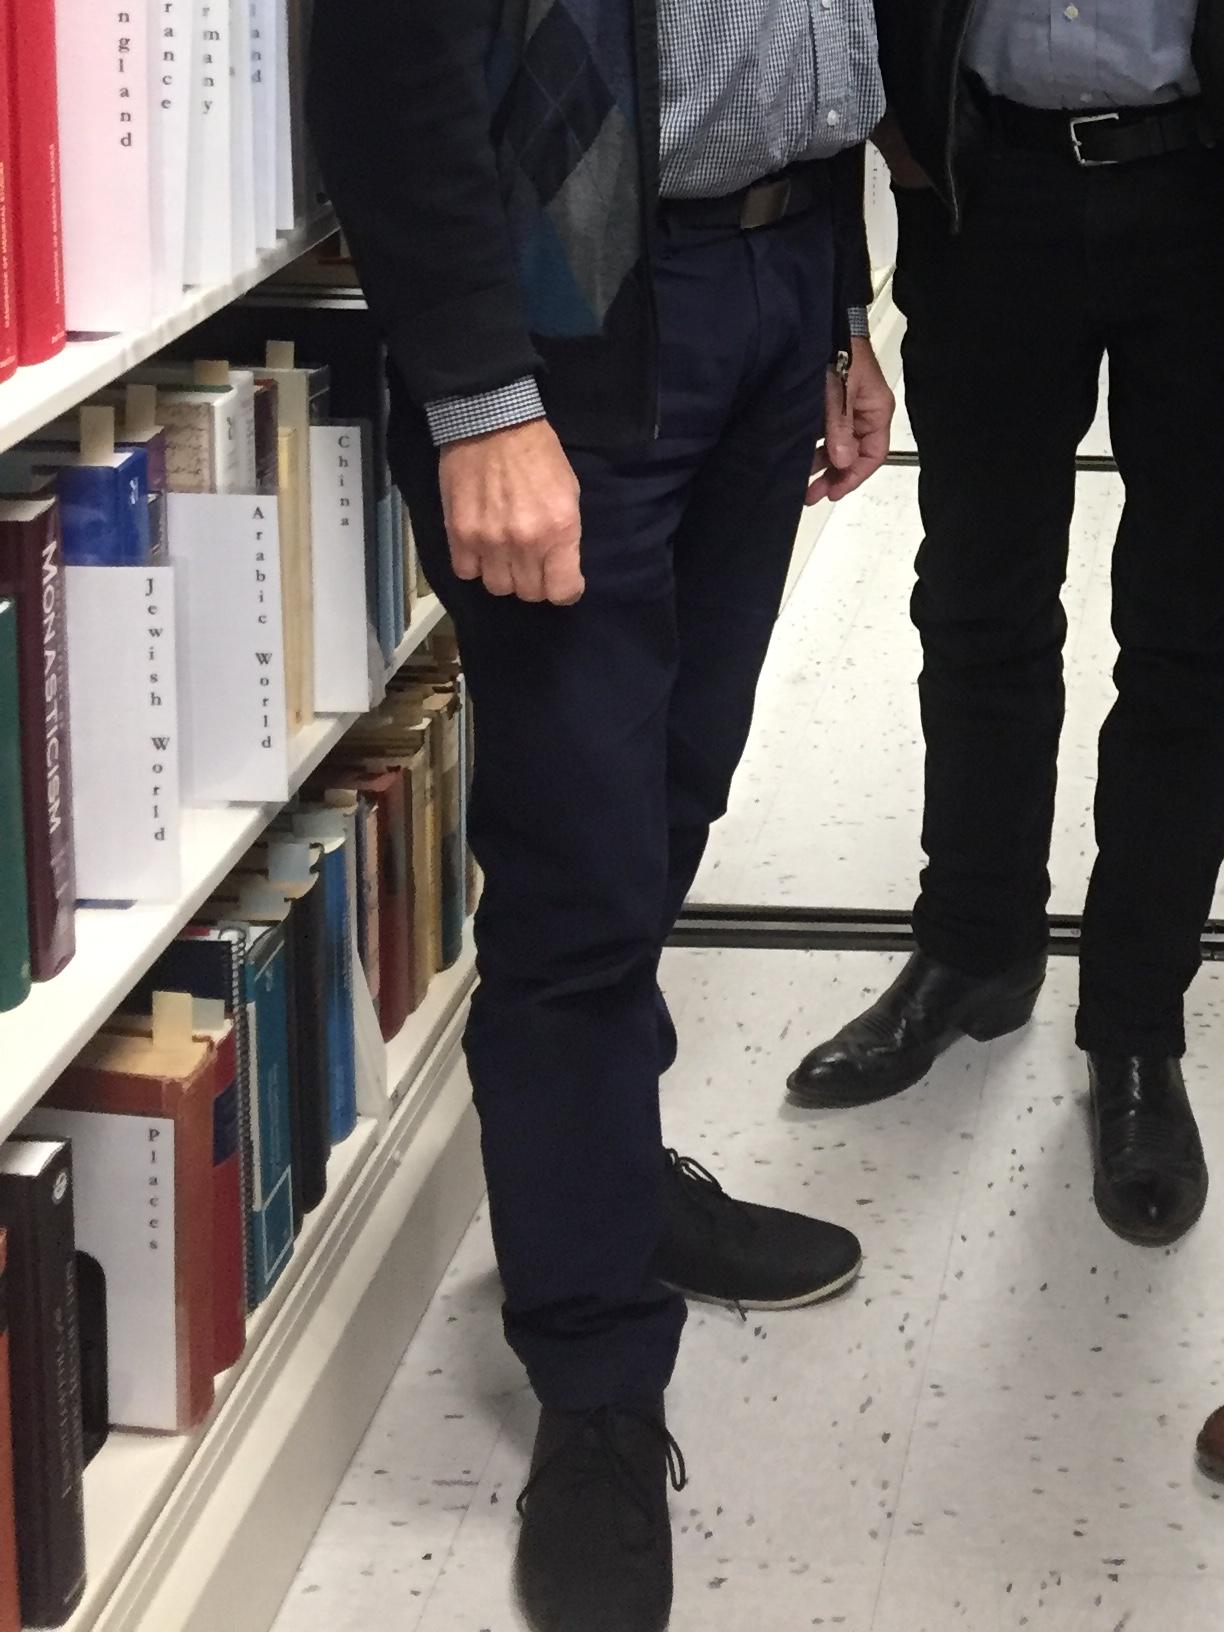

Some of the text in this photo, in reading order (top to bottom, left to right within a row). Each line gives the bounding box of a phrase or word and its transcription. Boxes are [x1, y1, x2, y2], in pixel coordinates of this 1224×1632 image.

[336, 435, 352, 528] China
[41, 540, 61, 835] MONASTICISM
[145, 577, 171, 843] Jewish World
[251, 505, 273, 749] Arabic World
[147, 1128, 161, 1251] Places
